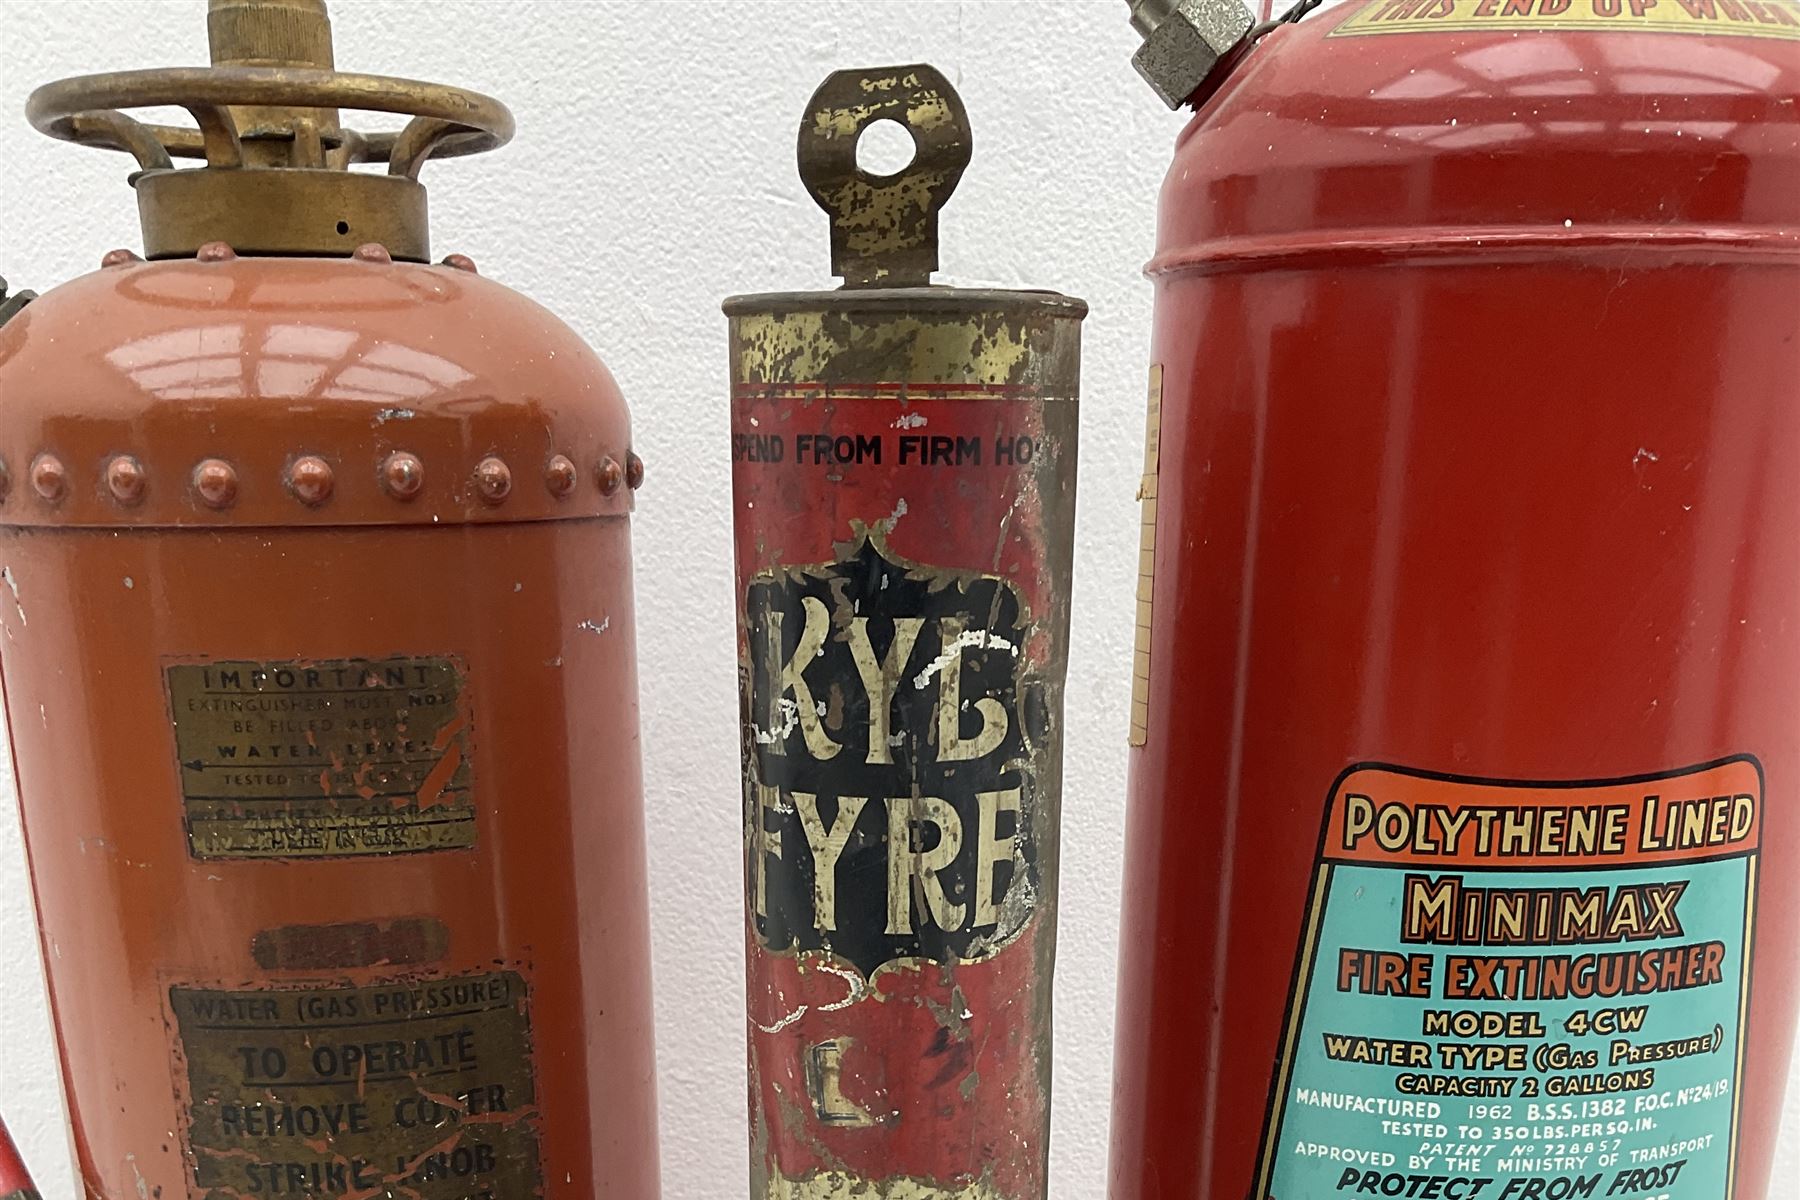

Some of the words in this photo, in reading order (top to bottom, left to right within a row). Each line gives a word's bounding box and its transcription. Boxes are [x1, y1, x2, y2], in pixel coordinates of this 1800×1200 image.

[795, 435, 882, 465] FROM
[900, 436, 981, 466] FIRM
[203, 666, 431, 689] IMPORTANT
[217, 745, 322, 759] WATER
[1343, 794, 1628, 857] POLYTHENE
[1639, 794, 1755, 855] LINED
[1401, 874, 1690, 946] MINIMAX
[1337, 948, 1434, 998] FIRE
[1444, 940, 1726, 1001] EXTINGUISHER
[192, 997, 280, 1022] WATER
[298, 996, 358, 1022] (GAS
[375, 977, 510, 1016] PRESSURE)
[1422, 1008, 1547, 1039] MODEL
[238, 1045, 286, 1080] TO
[312, 1029, 478, 1078] OPERATE
[1323, 1033, 1435, 1068] WATER
[1437, 1044, 1527, 1070] TYPE
[1396, 1073, 1517, 1098] CAPACITY
[1519, 1077, 1540, 1098] 2
[1545, 1069, 1656, 1097] GALLONS
[219, 1102, 370, 1138] REMOVE
[1295, 1088, 1441, 1119] MANUFACTURED
[1468, 1104, 1513, 1120] 1962
[1381, 1120, 1448, 1139] TESTED
[1458, 1125, 1483, 1140] TO
[1295, 1141, 1396, 1168] APPROVED
[1408, 1155, 1436, 1171] BY
[1445, 1157, 1482, 1173] THE
[1497, 1155, 1588, 1173] MINISTRY
[1597, 1153, 1619, 1168] OF
[1630, 1134, 1714, 1163] TRANSPORT
[1419, 1142, 1497, 1157] PATENT
[245, 1159, 375, 1193] STRIKE
[1336, 1167, 1494, 1200] PROTECT
[1606, 1159, 1688, 1197] FROST
